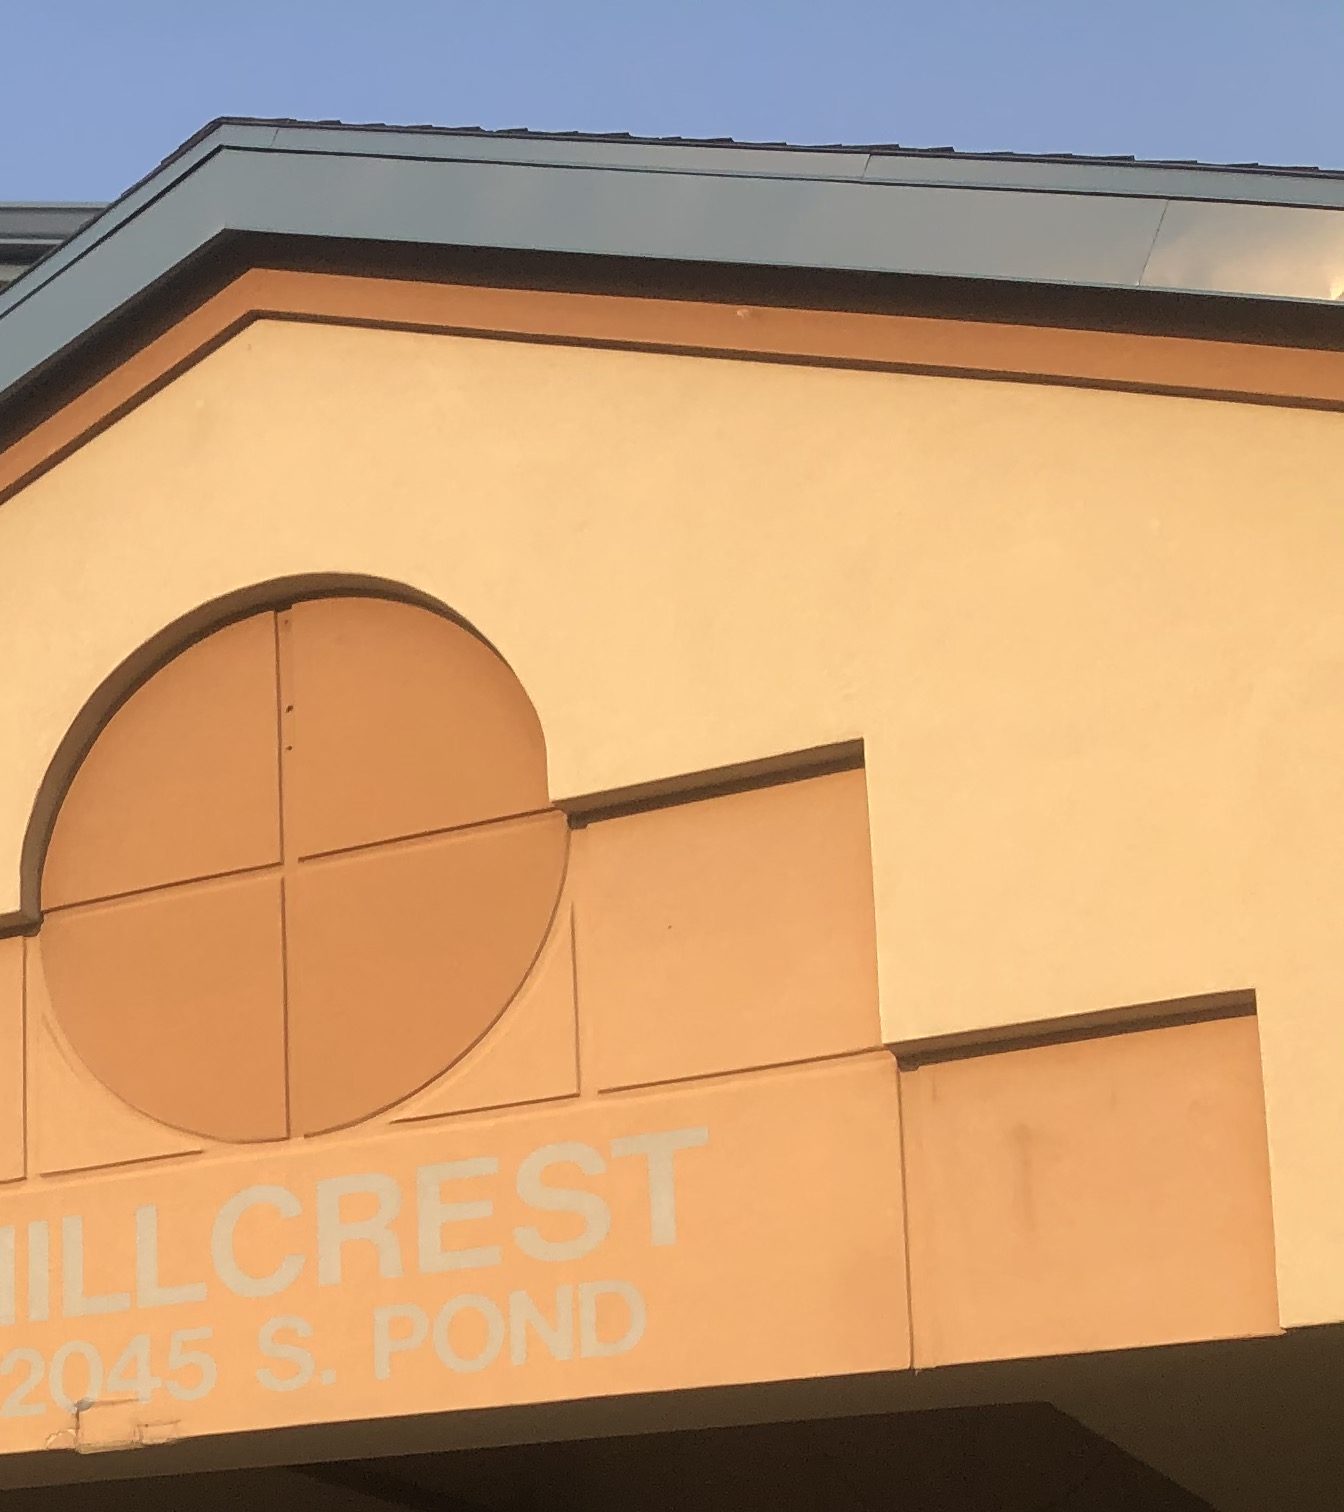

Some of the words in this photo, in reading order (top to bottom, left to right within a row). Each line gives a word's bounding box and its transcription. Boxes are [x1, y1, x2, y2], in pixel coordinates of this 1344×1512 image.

[0, 1327, 218, 1419] 2045
[256, 1315, 338, 1393] S.
[374, 1280, 647, 1380] POND
